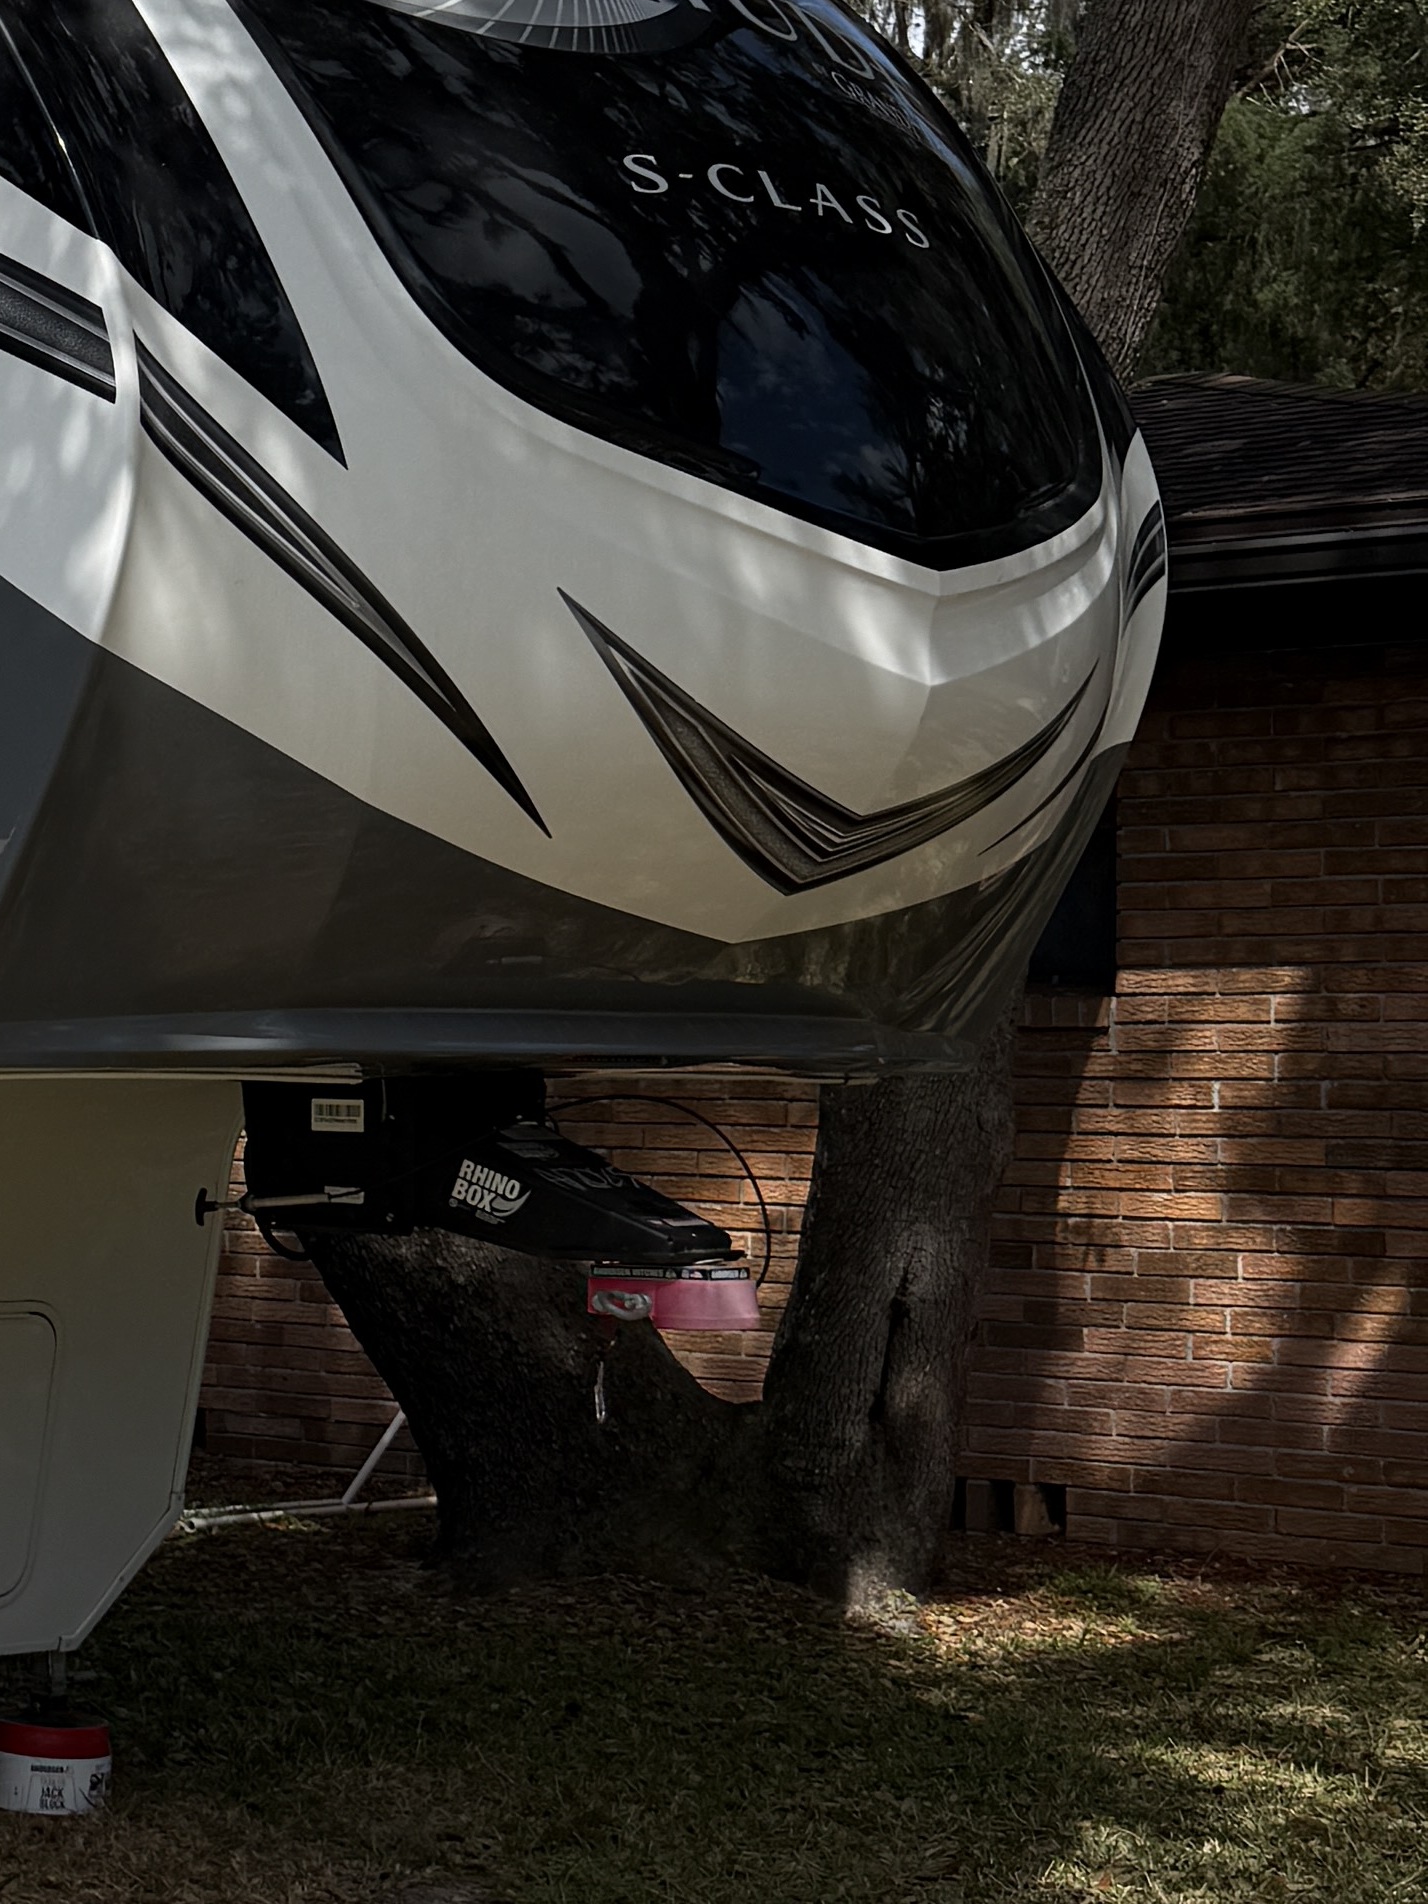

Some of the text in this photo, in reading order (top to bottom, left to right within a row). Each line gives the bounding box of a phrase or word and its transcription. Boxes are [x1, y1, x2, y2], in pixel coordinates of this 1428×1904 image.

[622, 153, 930, 249] S-CLASS
[450, 1177, 498, 1214] BOX
[457, 1157, 521, 1200] RHINO
